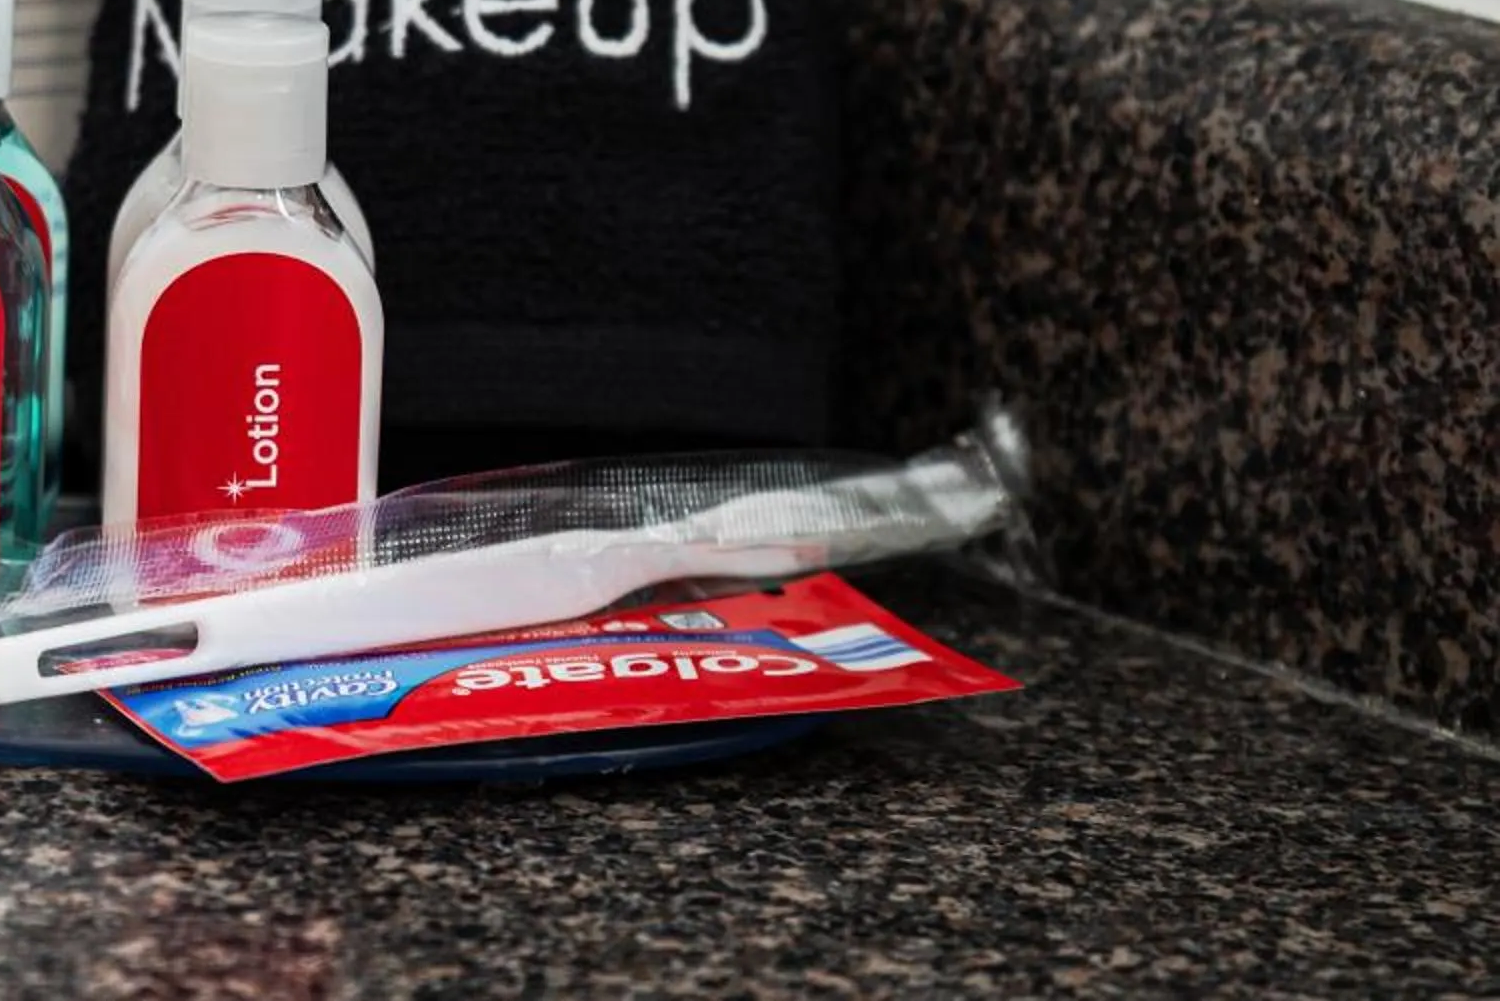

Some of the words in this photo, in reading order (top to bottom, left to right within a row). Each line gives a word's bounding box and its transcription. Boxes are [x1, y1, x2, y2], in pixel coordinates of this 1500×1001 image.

[245, 364, 281, 487] Lotion
[243, 670, 394, 700] Protection
[453, 652, 819, 690] Colgate
[246, 678, 398, 715] Cavity
